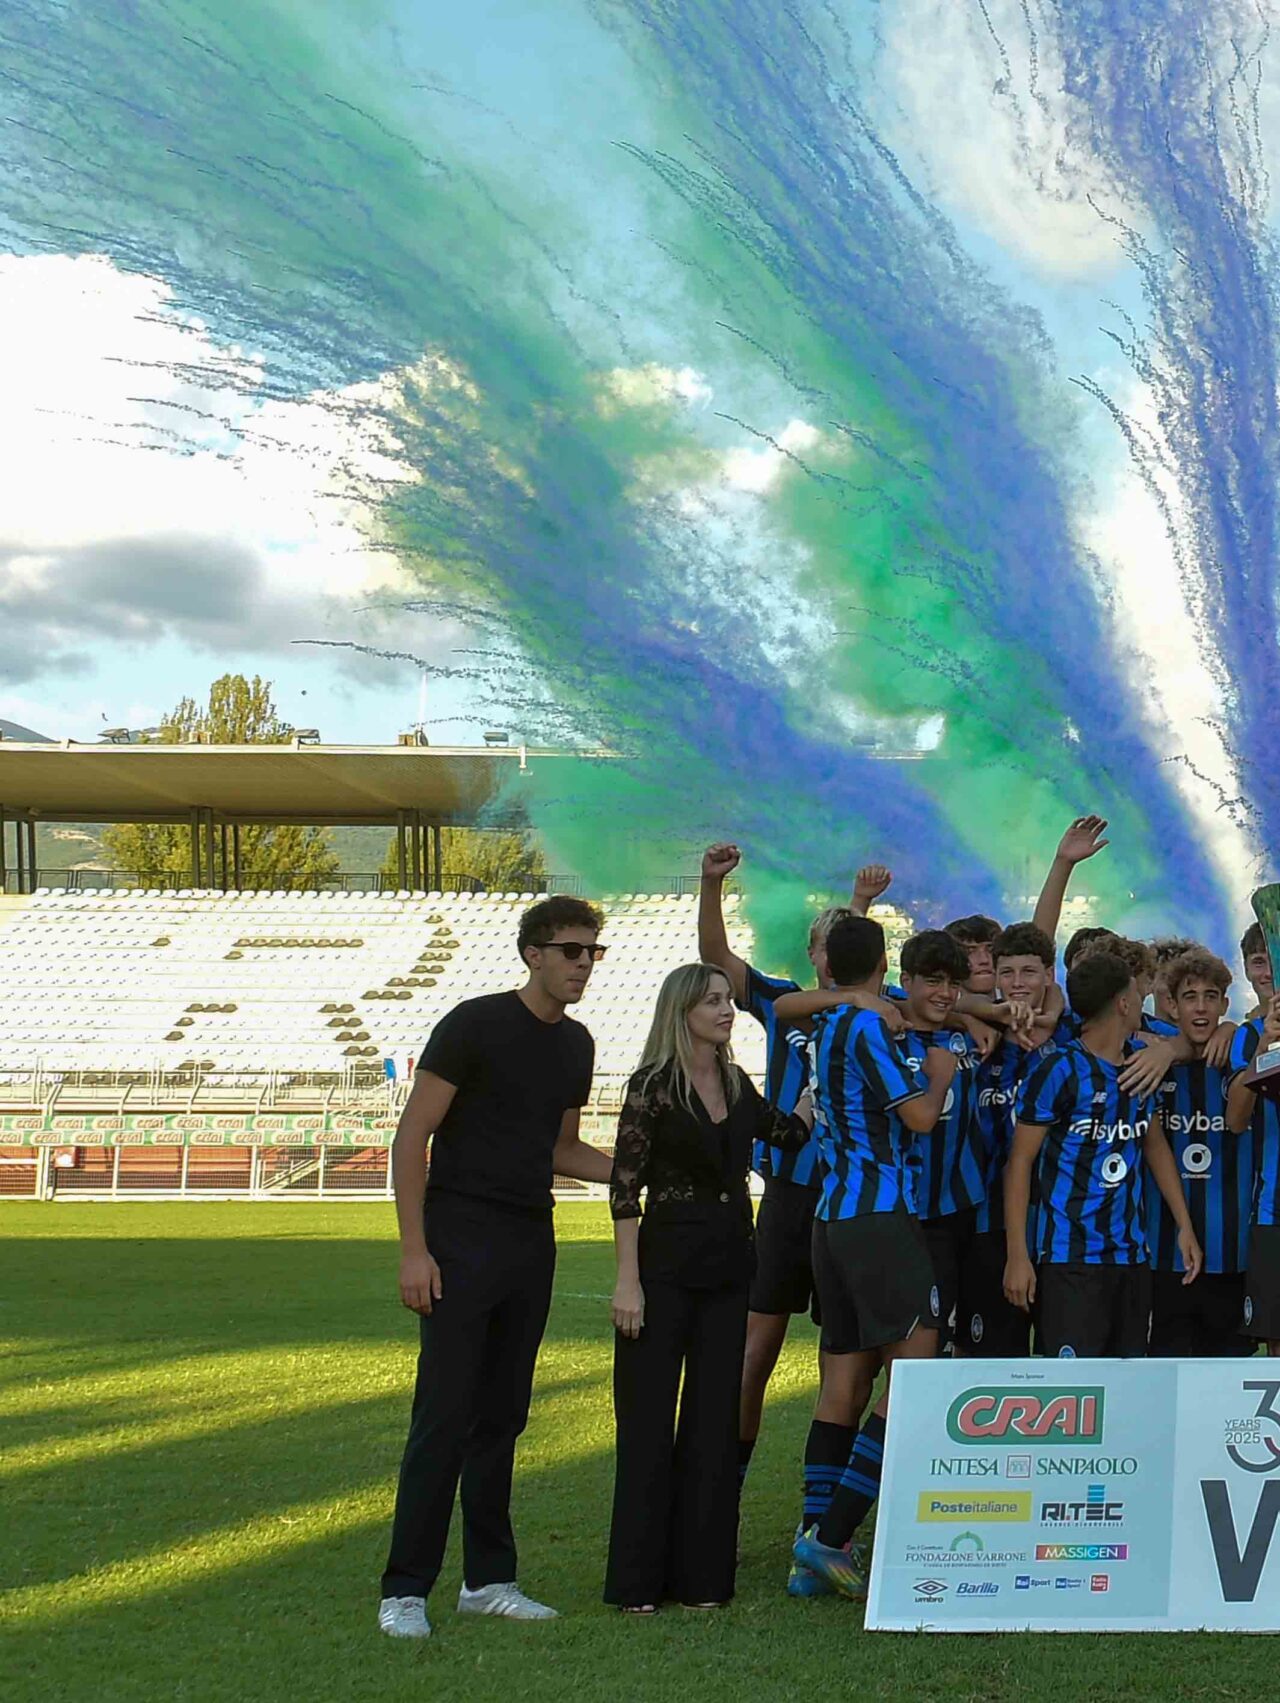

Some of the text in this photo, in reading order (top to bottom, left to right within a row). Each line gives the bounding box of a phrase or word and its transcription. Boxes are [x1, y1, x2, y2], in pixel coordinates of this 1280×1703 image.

[957, 1395, 1097, 1437] CRAI
[1225, 1419, 1261, 1429] YEARS
[1225, 1432, 1261, 1444] 2025
[929, 1457, 1138, 1476] INTESA SANPAOLO
[905, 1553, 1027, 1562] FONDAZIONE VARRONE
[1045, 1547, 1118, 1558] MASSIGEN
[956, 1582, 999, 1594] Barilla
